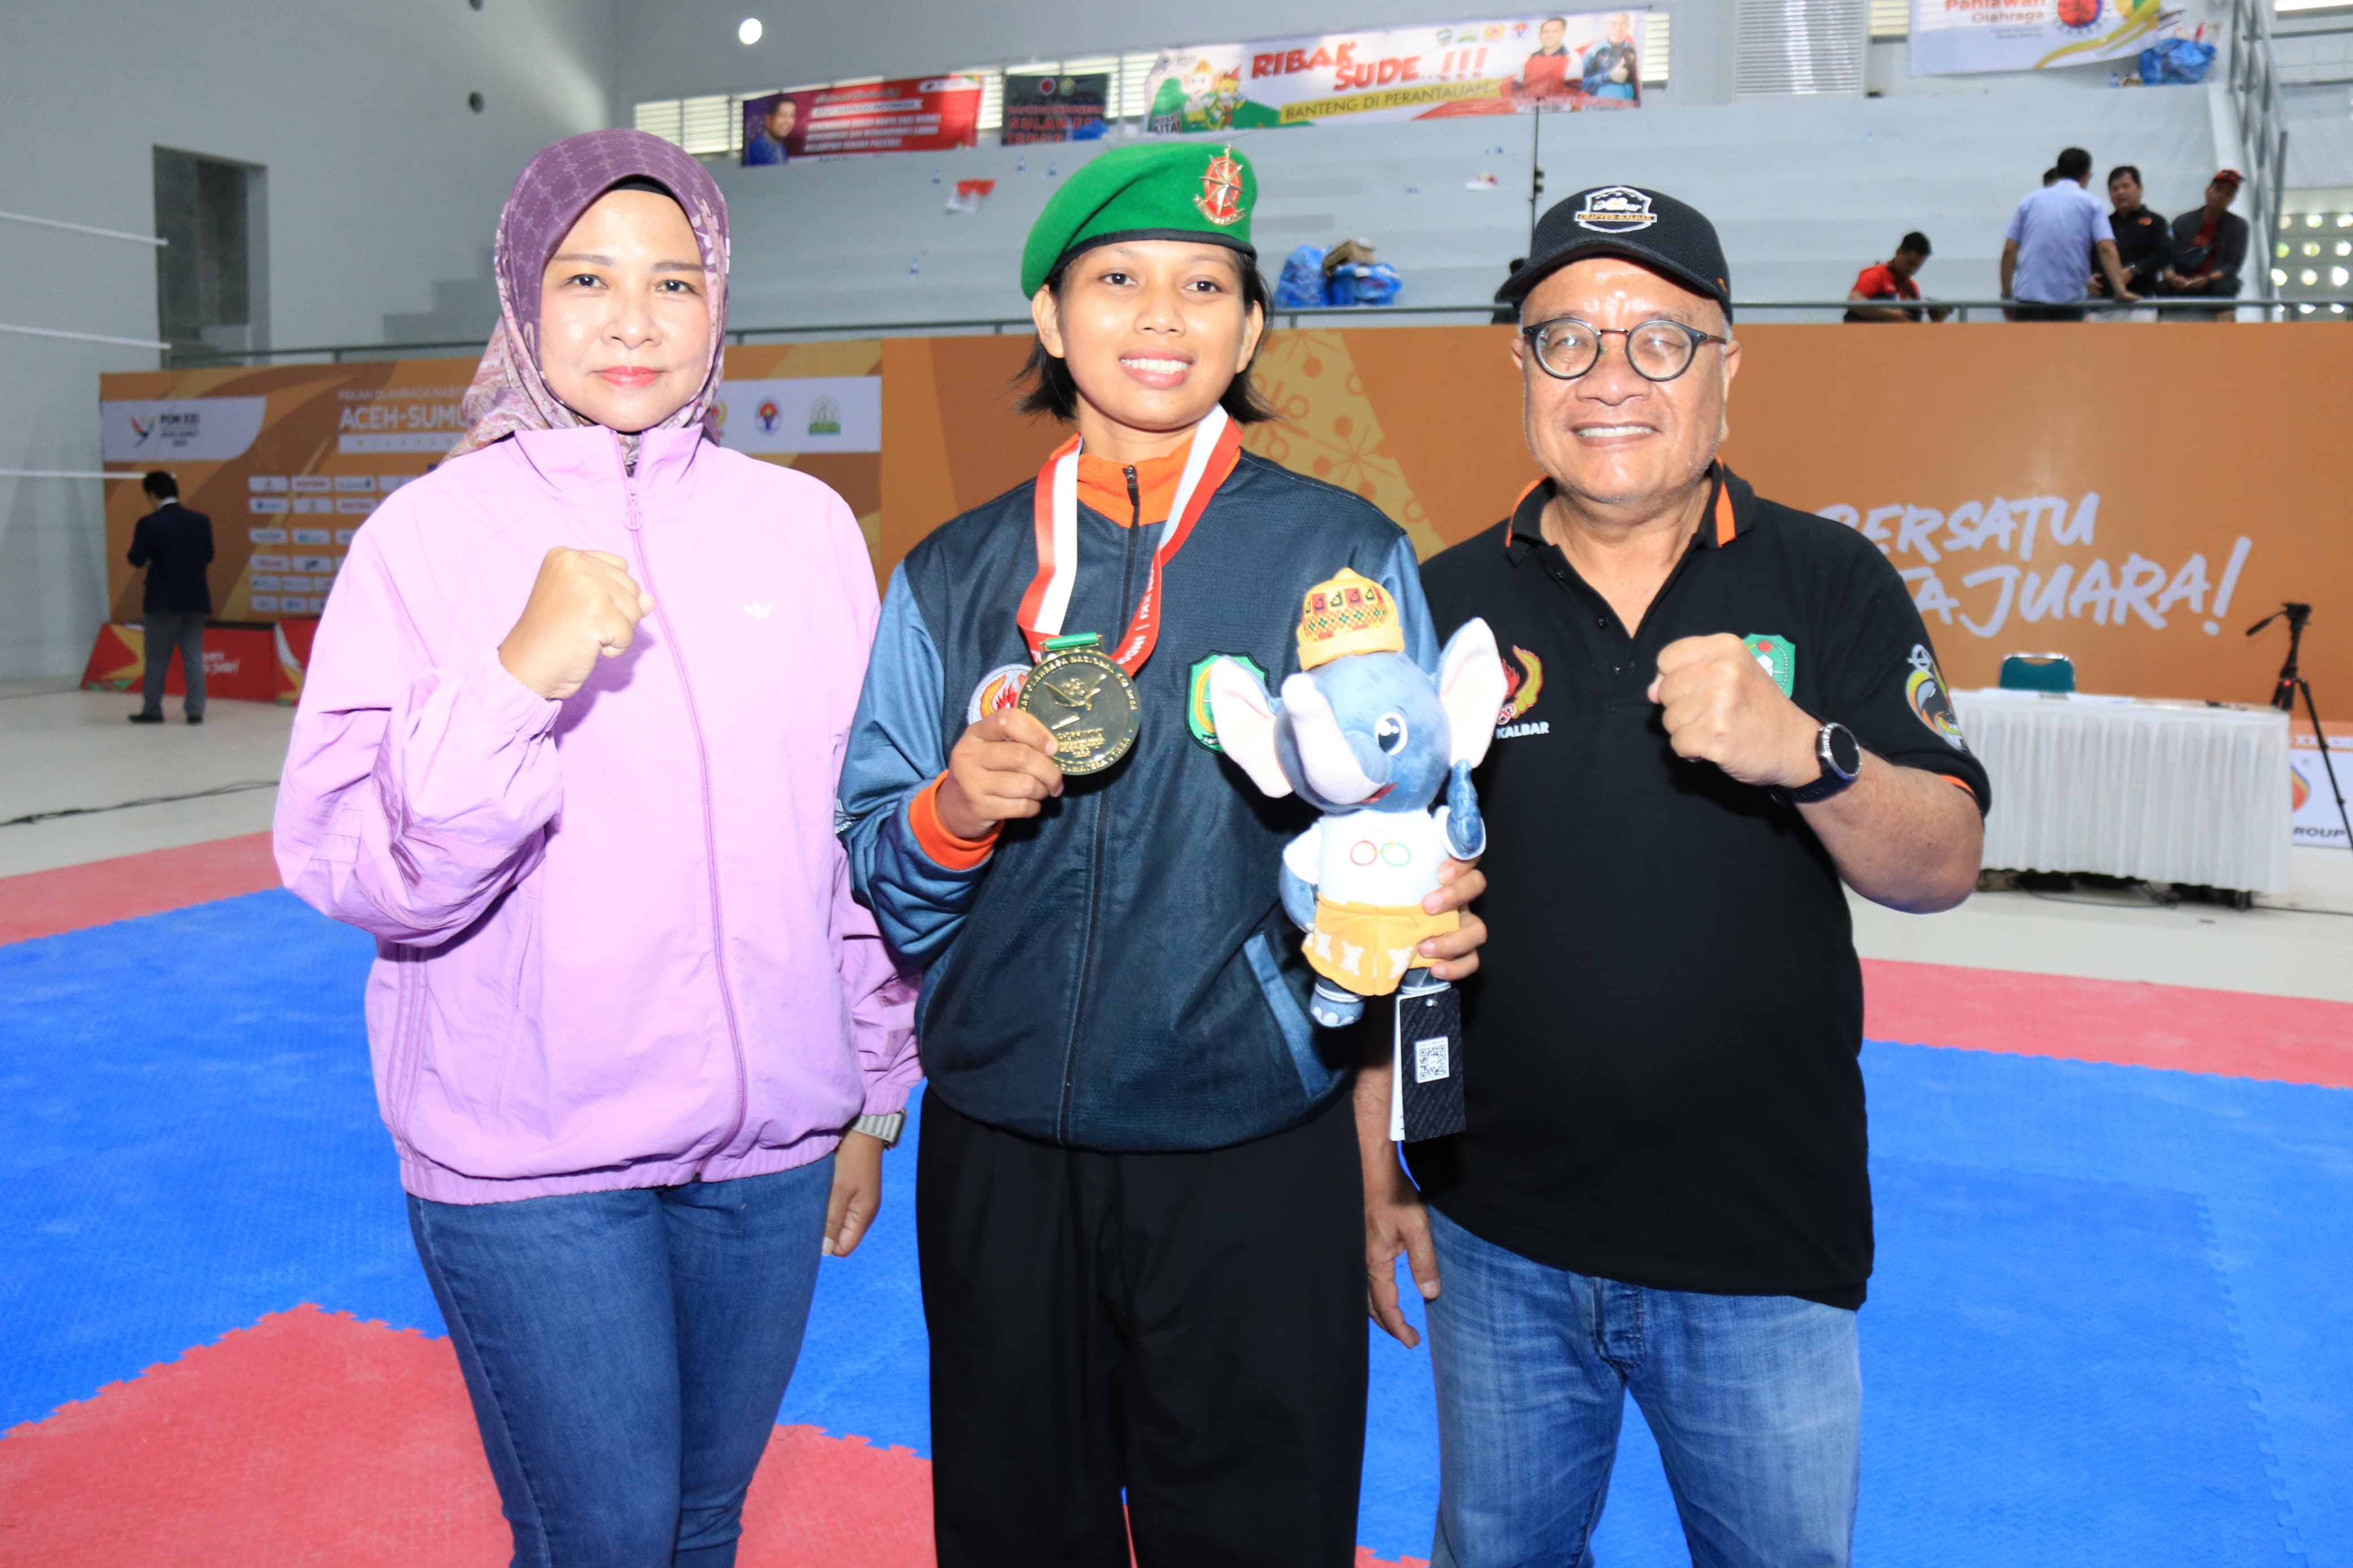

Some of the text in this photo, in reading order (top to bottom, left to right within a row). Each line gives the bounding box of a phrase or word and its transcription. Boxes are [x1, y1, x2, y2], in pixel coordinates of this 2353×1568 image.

[1971, 9, 2045, 23] Olahraga
[1251, 41, 1358, 79] RIBAK
[1286, 100, 1359, 119] BANTENG
[1364, 95, 1379, 109] DI
[1385, 82, 1489, 107] PERANTAUAN
[1959, 536, 2252, 638] JUARA!
[1496, 721, 1550, 739] KALBAR
